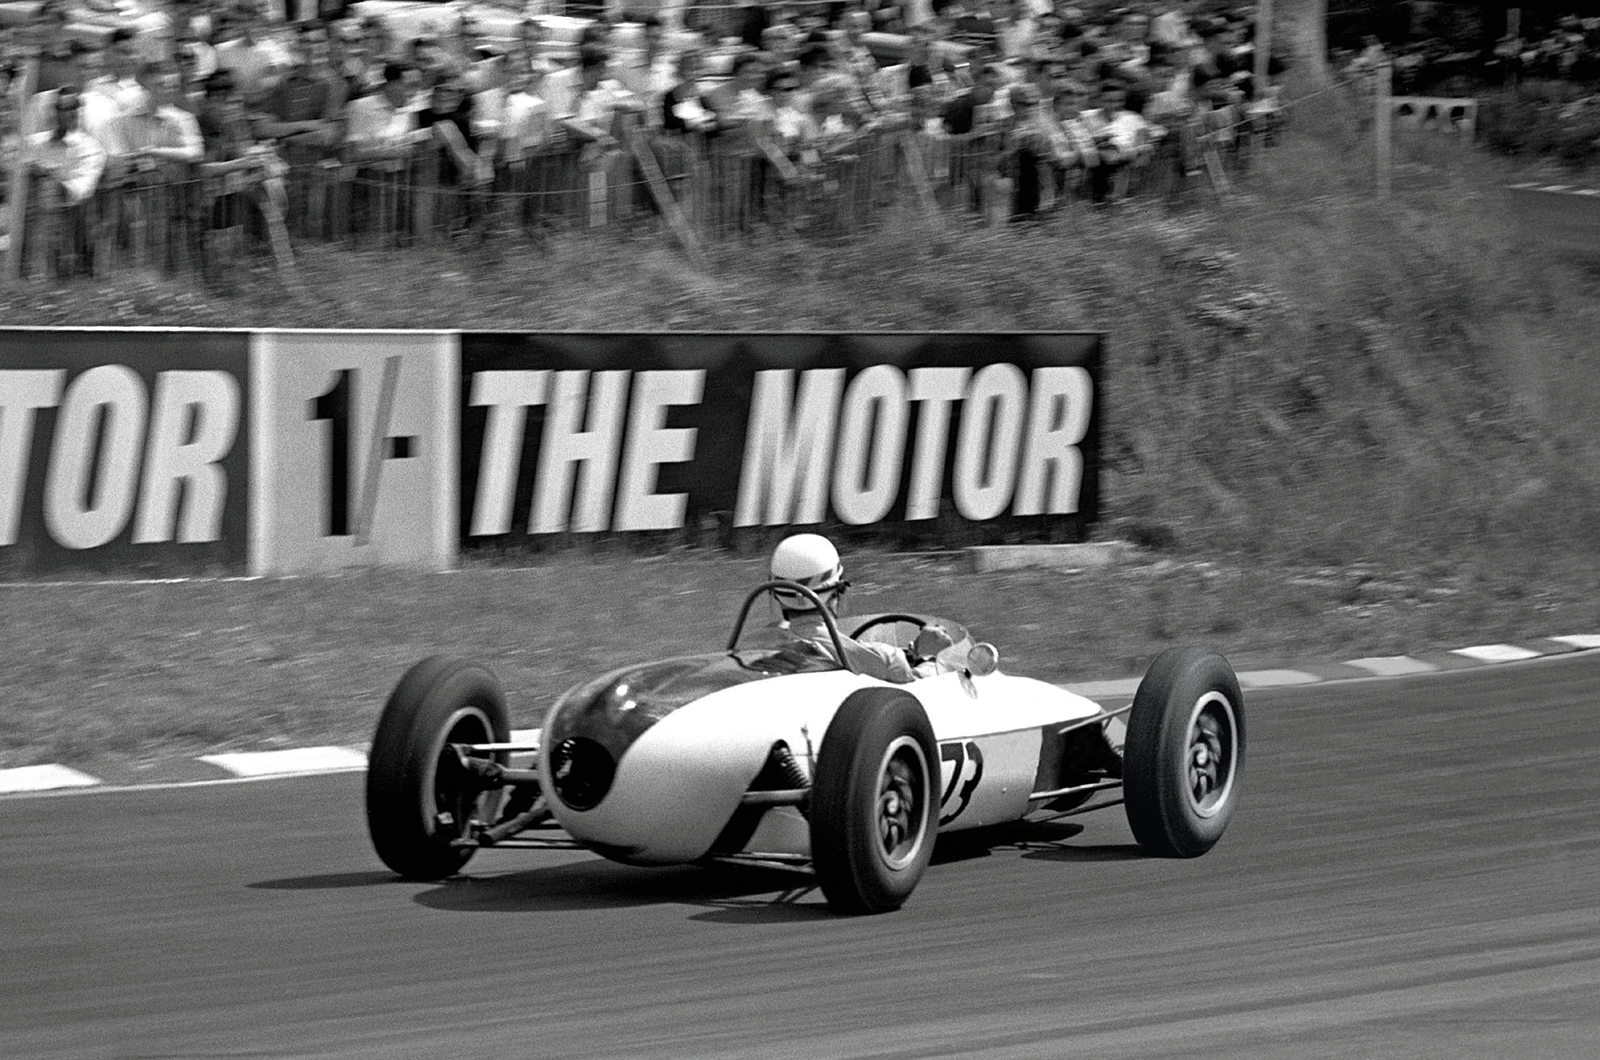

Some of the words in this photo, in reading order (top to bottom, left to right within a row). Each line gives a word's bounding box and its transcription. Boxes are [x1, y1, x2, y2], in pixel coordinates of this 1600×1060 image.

[0, 364, 240, 549] TOR
[468, 369, 707, 536] THE
[733, 362, 1093, 526] MOTOR
